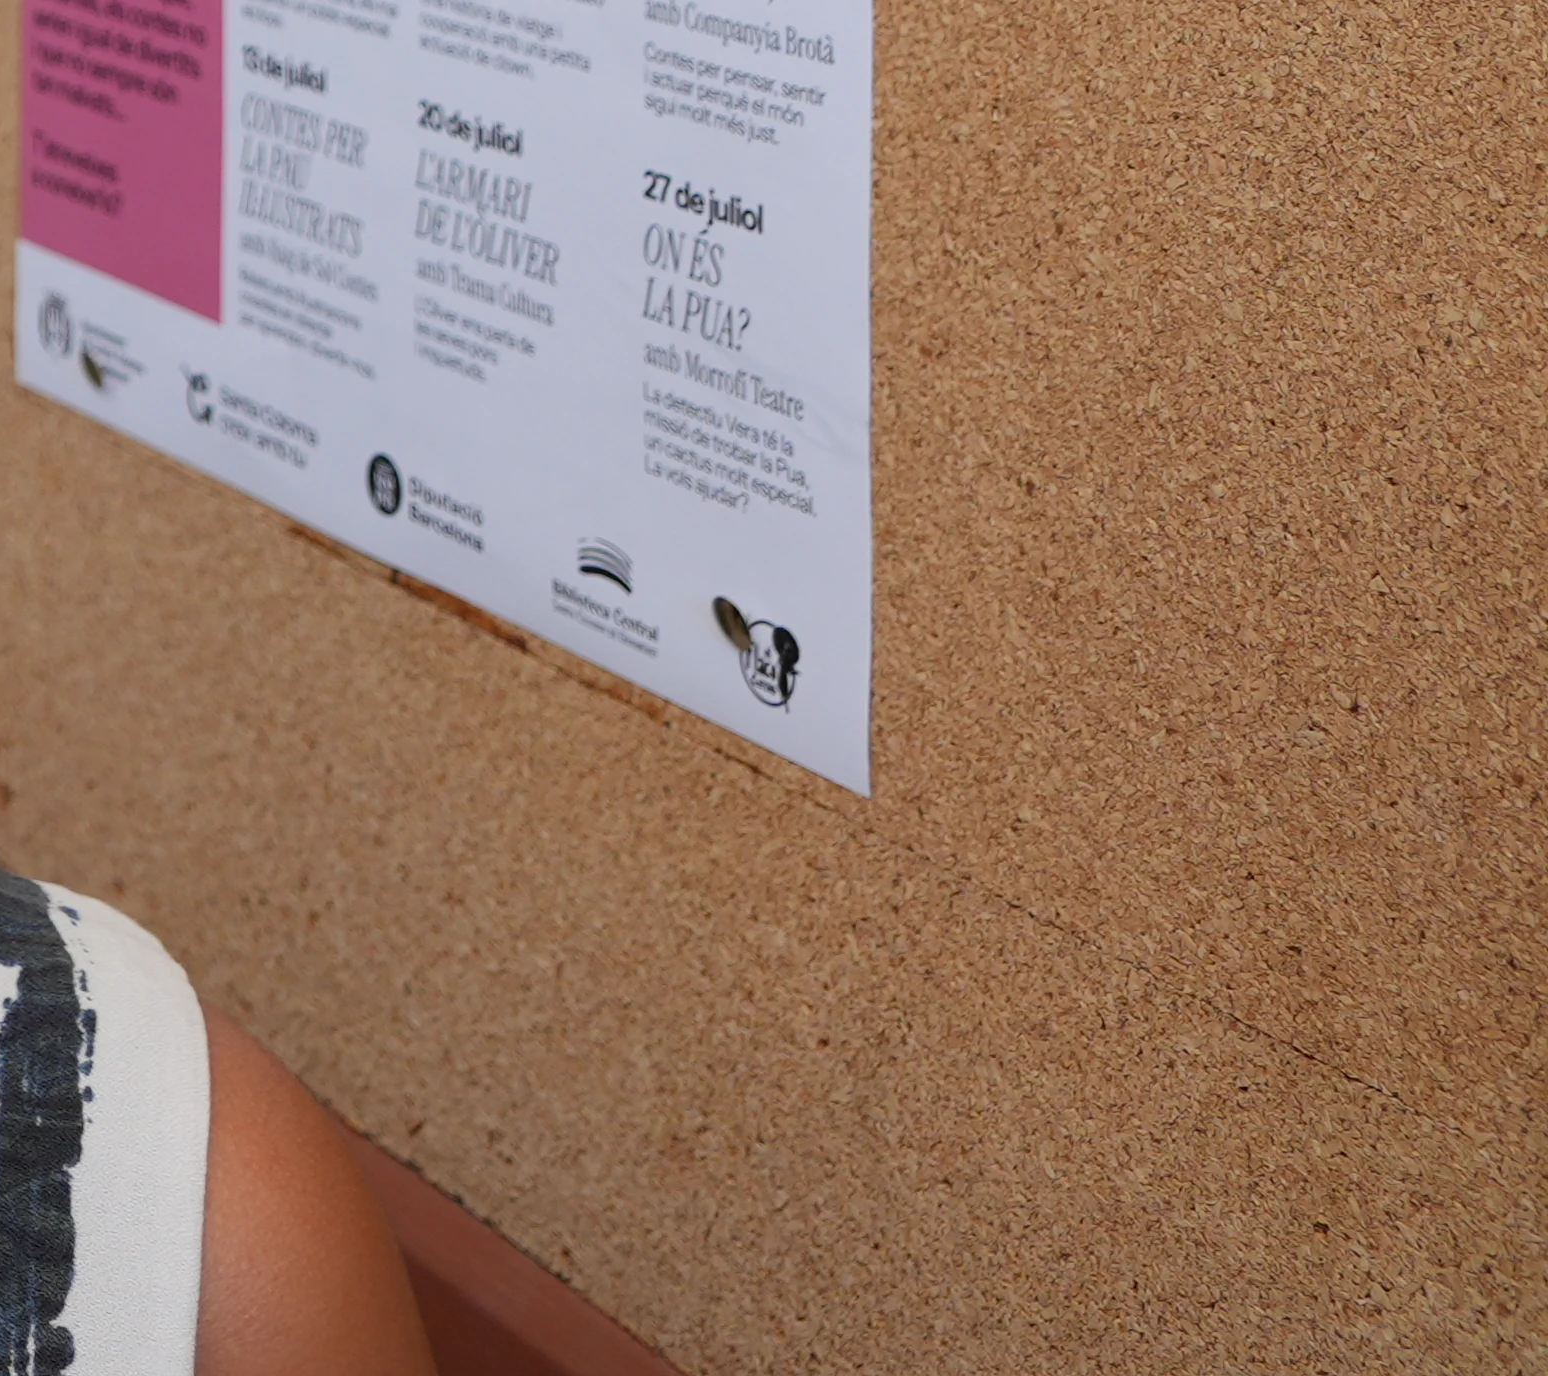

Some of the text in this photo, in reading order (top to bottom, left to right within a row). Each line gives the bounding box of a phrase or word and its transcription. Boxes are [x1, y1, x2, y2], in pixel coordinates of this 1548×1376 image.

[643, 40, 695, 72] Contes
[696, 60, 722, 78] per
[684, 0, 781, 55] Companyia
[785, 23, 837, 66] Brotà
[240, 90, 370, 169] CONTES PER
[418, 98, 525, 158] 20 de juliol
[768, 103, 805, 128] món
[414, 148, 534, 224] L'ARMARI
[643, 170, 765, 235] 27 de juliol
[414, 198, 450, 246] DE
[642, 222, 725, 288] ON ÉS
[642, 276, 752, 353] LA PUA?
[643, 342, 682, 376] amb
[750, 375, 805, 423] Teatre
[725, 413, 760, 445] Vera
